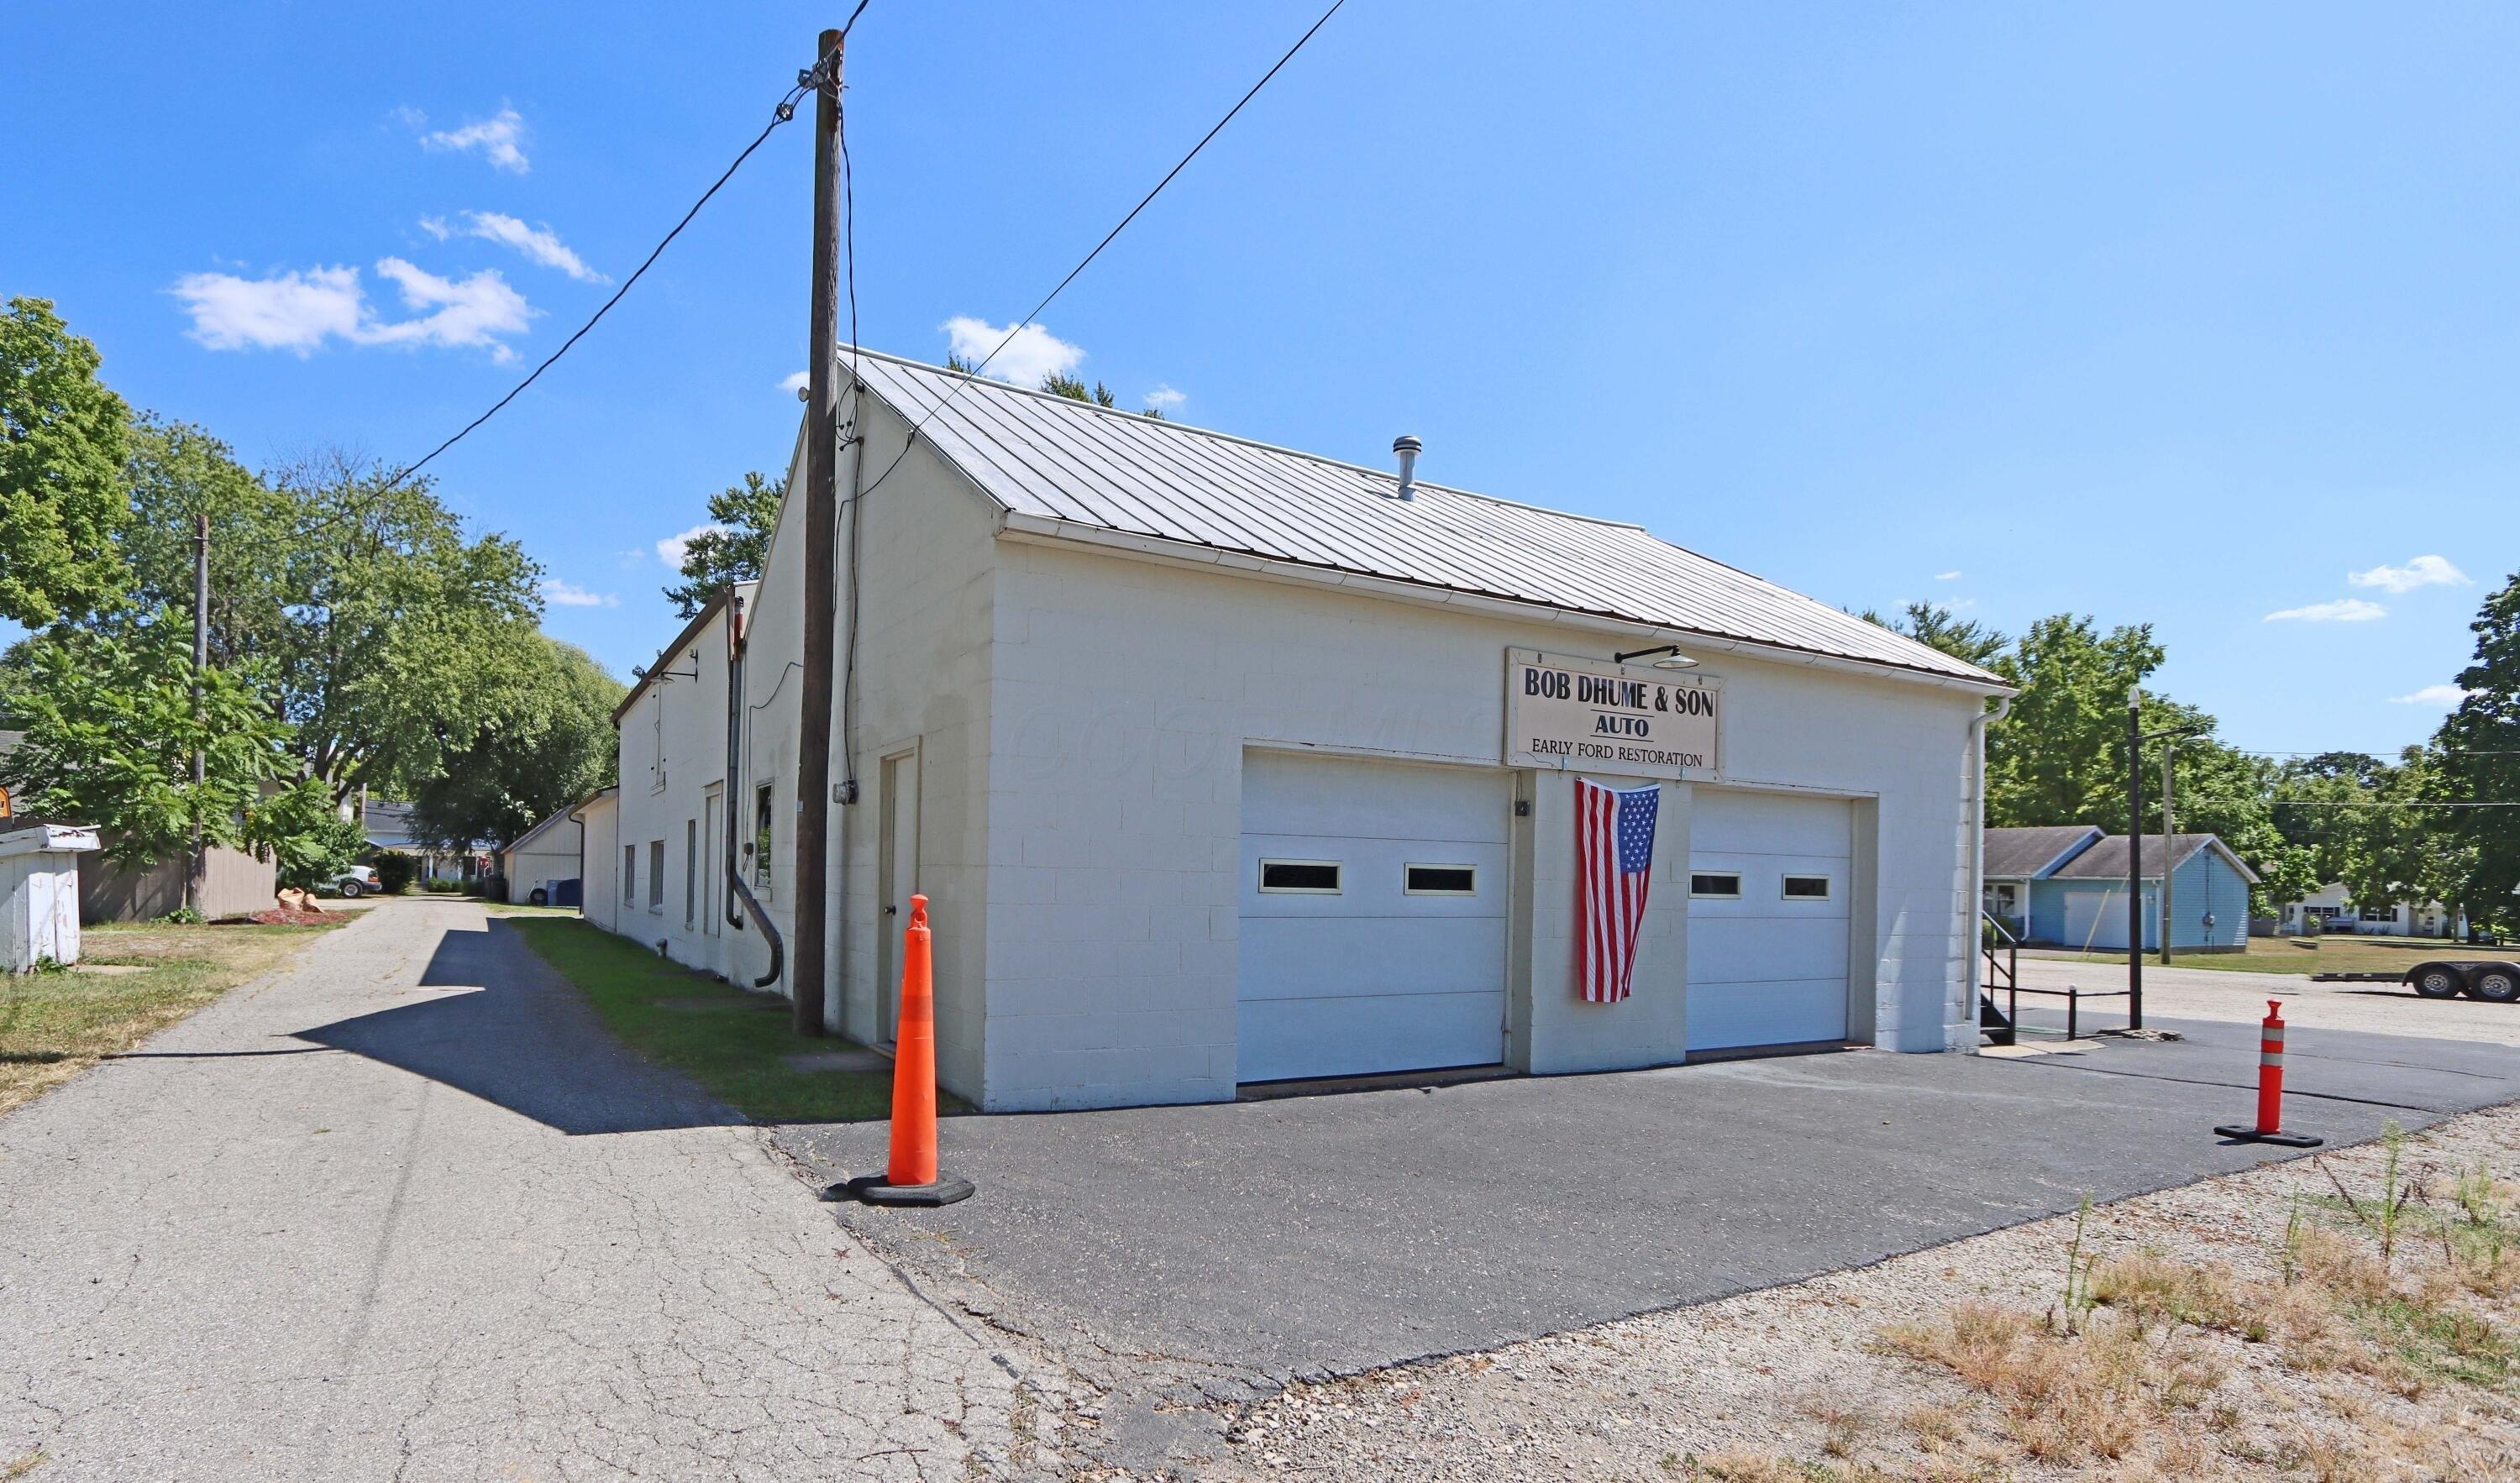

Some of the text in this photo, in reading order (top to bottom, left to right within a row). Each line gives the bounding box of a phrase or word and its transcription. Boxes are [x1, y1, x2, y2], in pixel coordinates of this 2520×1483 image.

[1525, 668, 1714, 717] BOB DHUME & SON
[1594, 715, 1649, 737] AUTO
[1531, 738, 1703, 768] EARLY FORD RESTORATION
